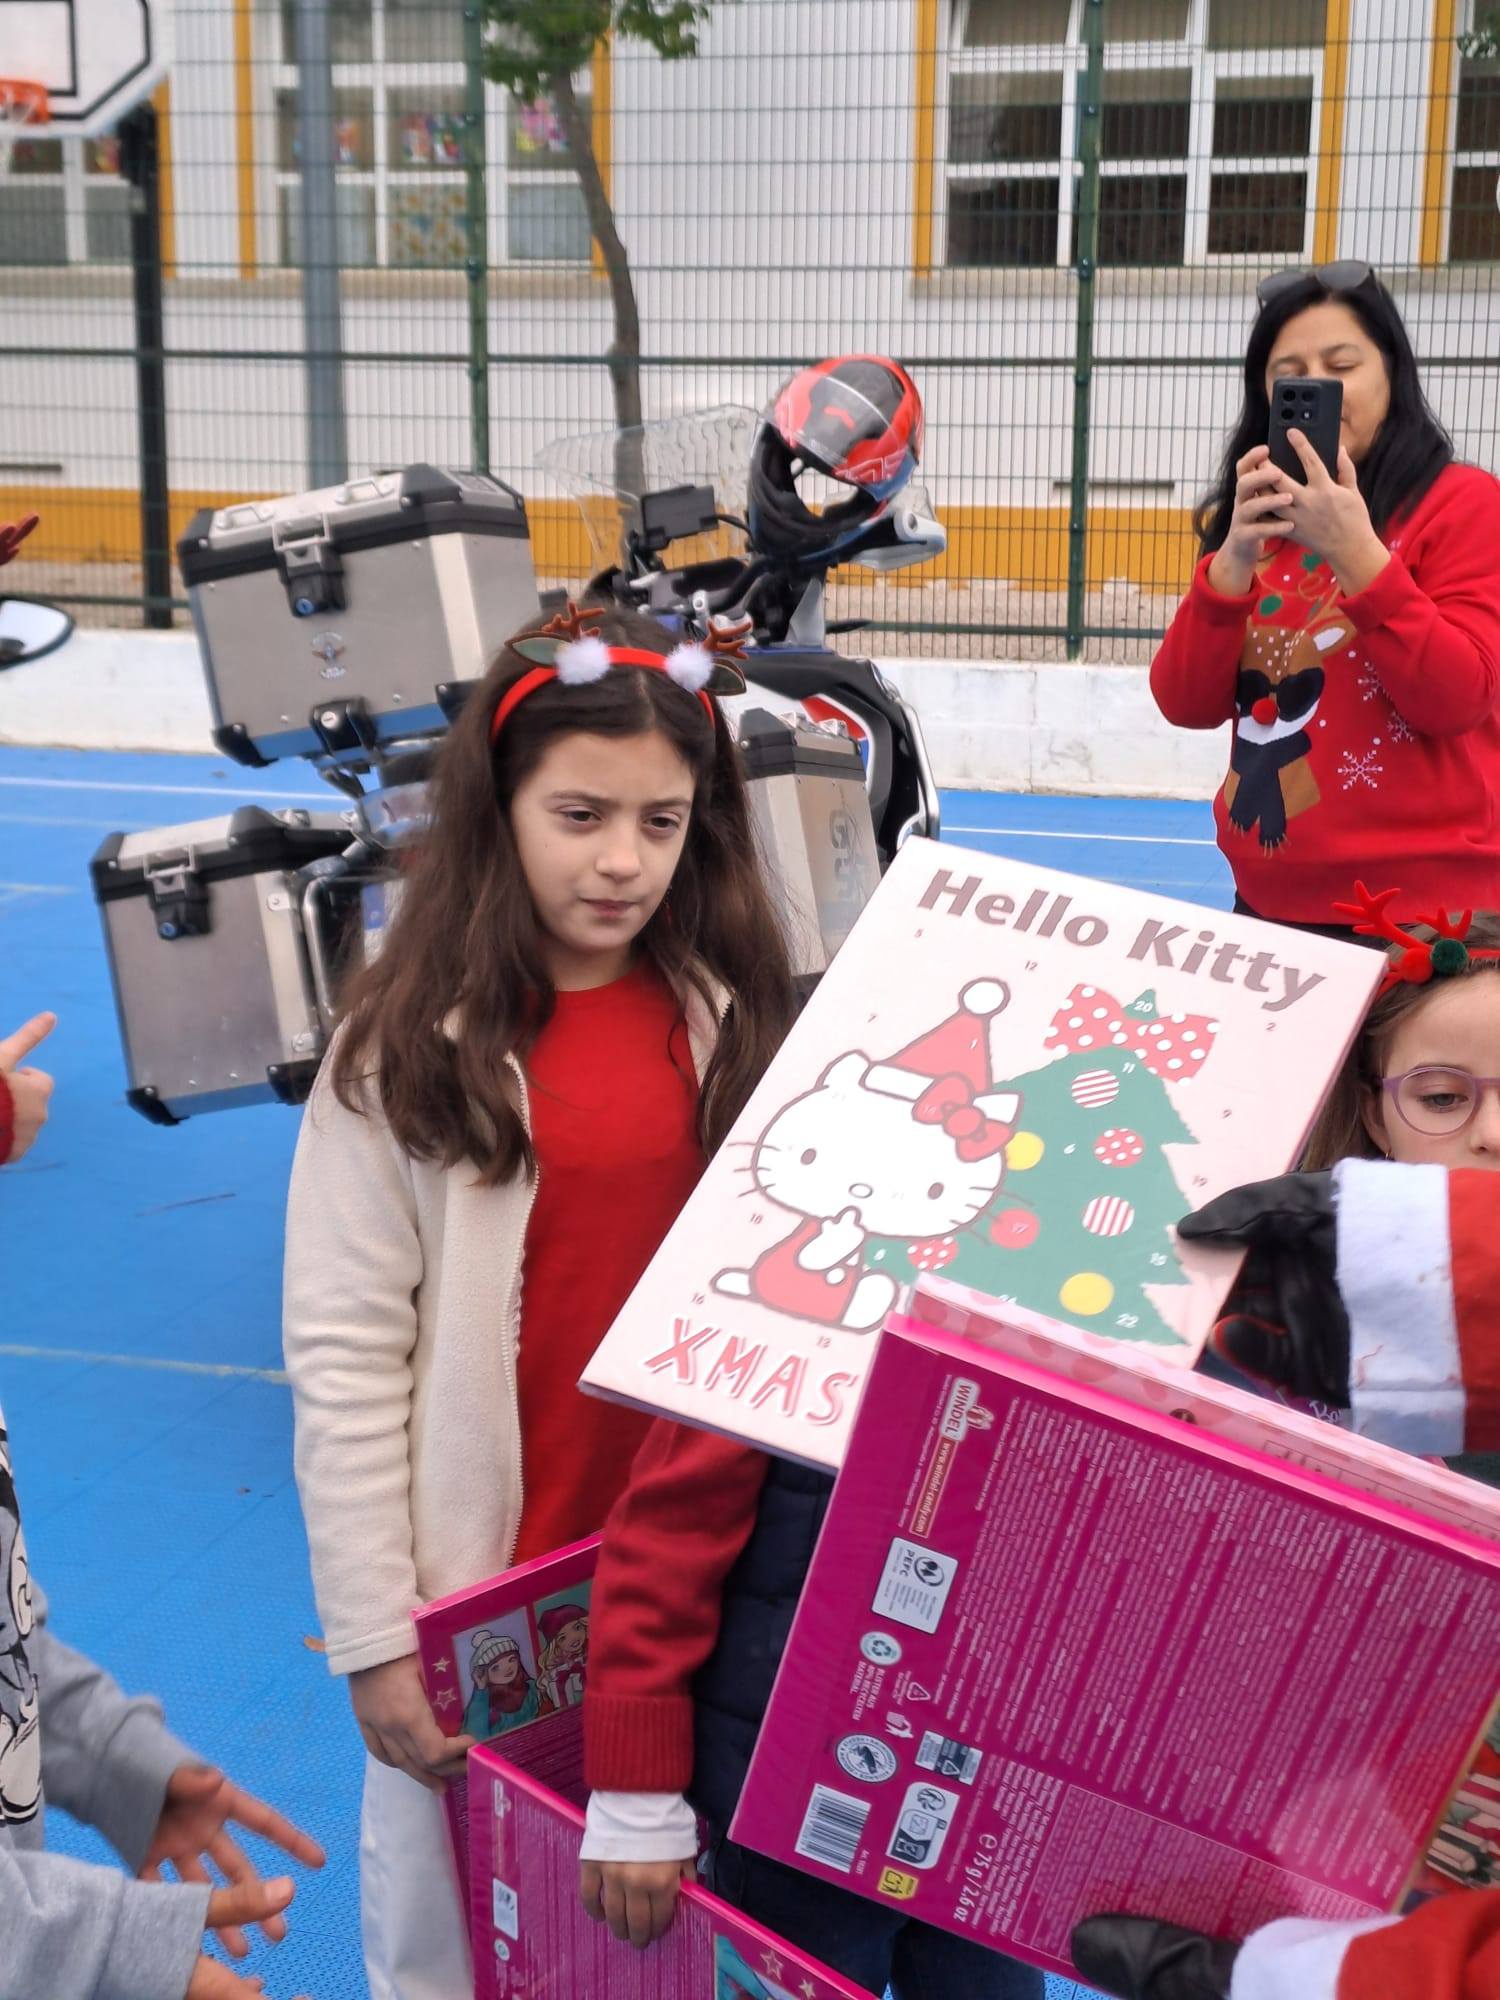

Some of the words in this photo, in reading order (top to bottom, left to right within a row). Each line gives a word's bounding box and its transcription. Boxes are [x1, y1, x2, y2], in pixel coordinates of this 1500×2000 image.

[917, 869, 1109, 947] Hello
[1127, 919, 1327, 1012] Kitty
[1024, 960, 1038, 971] 12
[1136, 1000, 1153, 1014] 20
[868, 1014, 876, 1024] 7
[1266, 1022, 1276, 1033] 2
[970, 1037, 978, 1049] 1
[1123, 1061, 1136, 1073] 11
[1063, 1143, 1077, 1155] 6
[1115, 1312, 1140, 1329] 22
[644, 1317, 859, 1426] XMAS
[945, 1384, 971, 1434] WINDEL
[915, 1442, 951, 1533] www.windel-candy.com
[900, 1549, 916, 1577] PEFC
[974, 1850, 993, 1868] 75
[964, 1866, 983, 1879] g
[952, 1906, 969, 1923] oz
